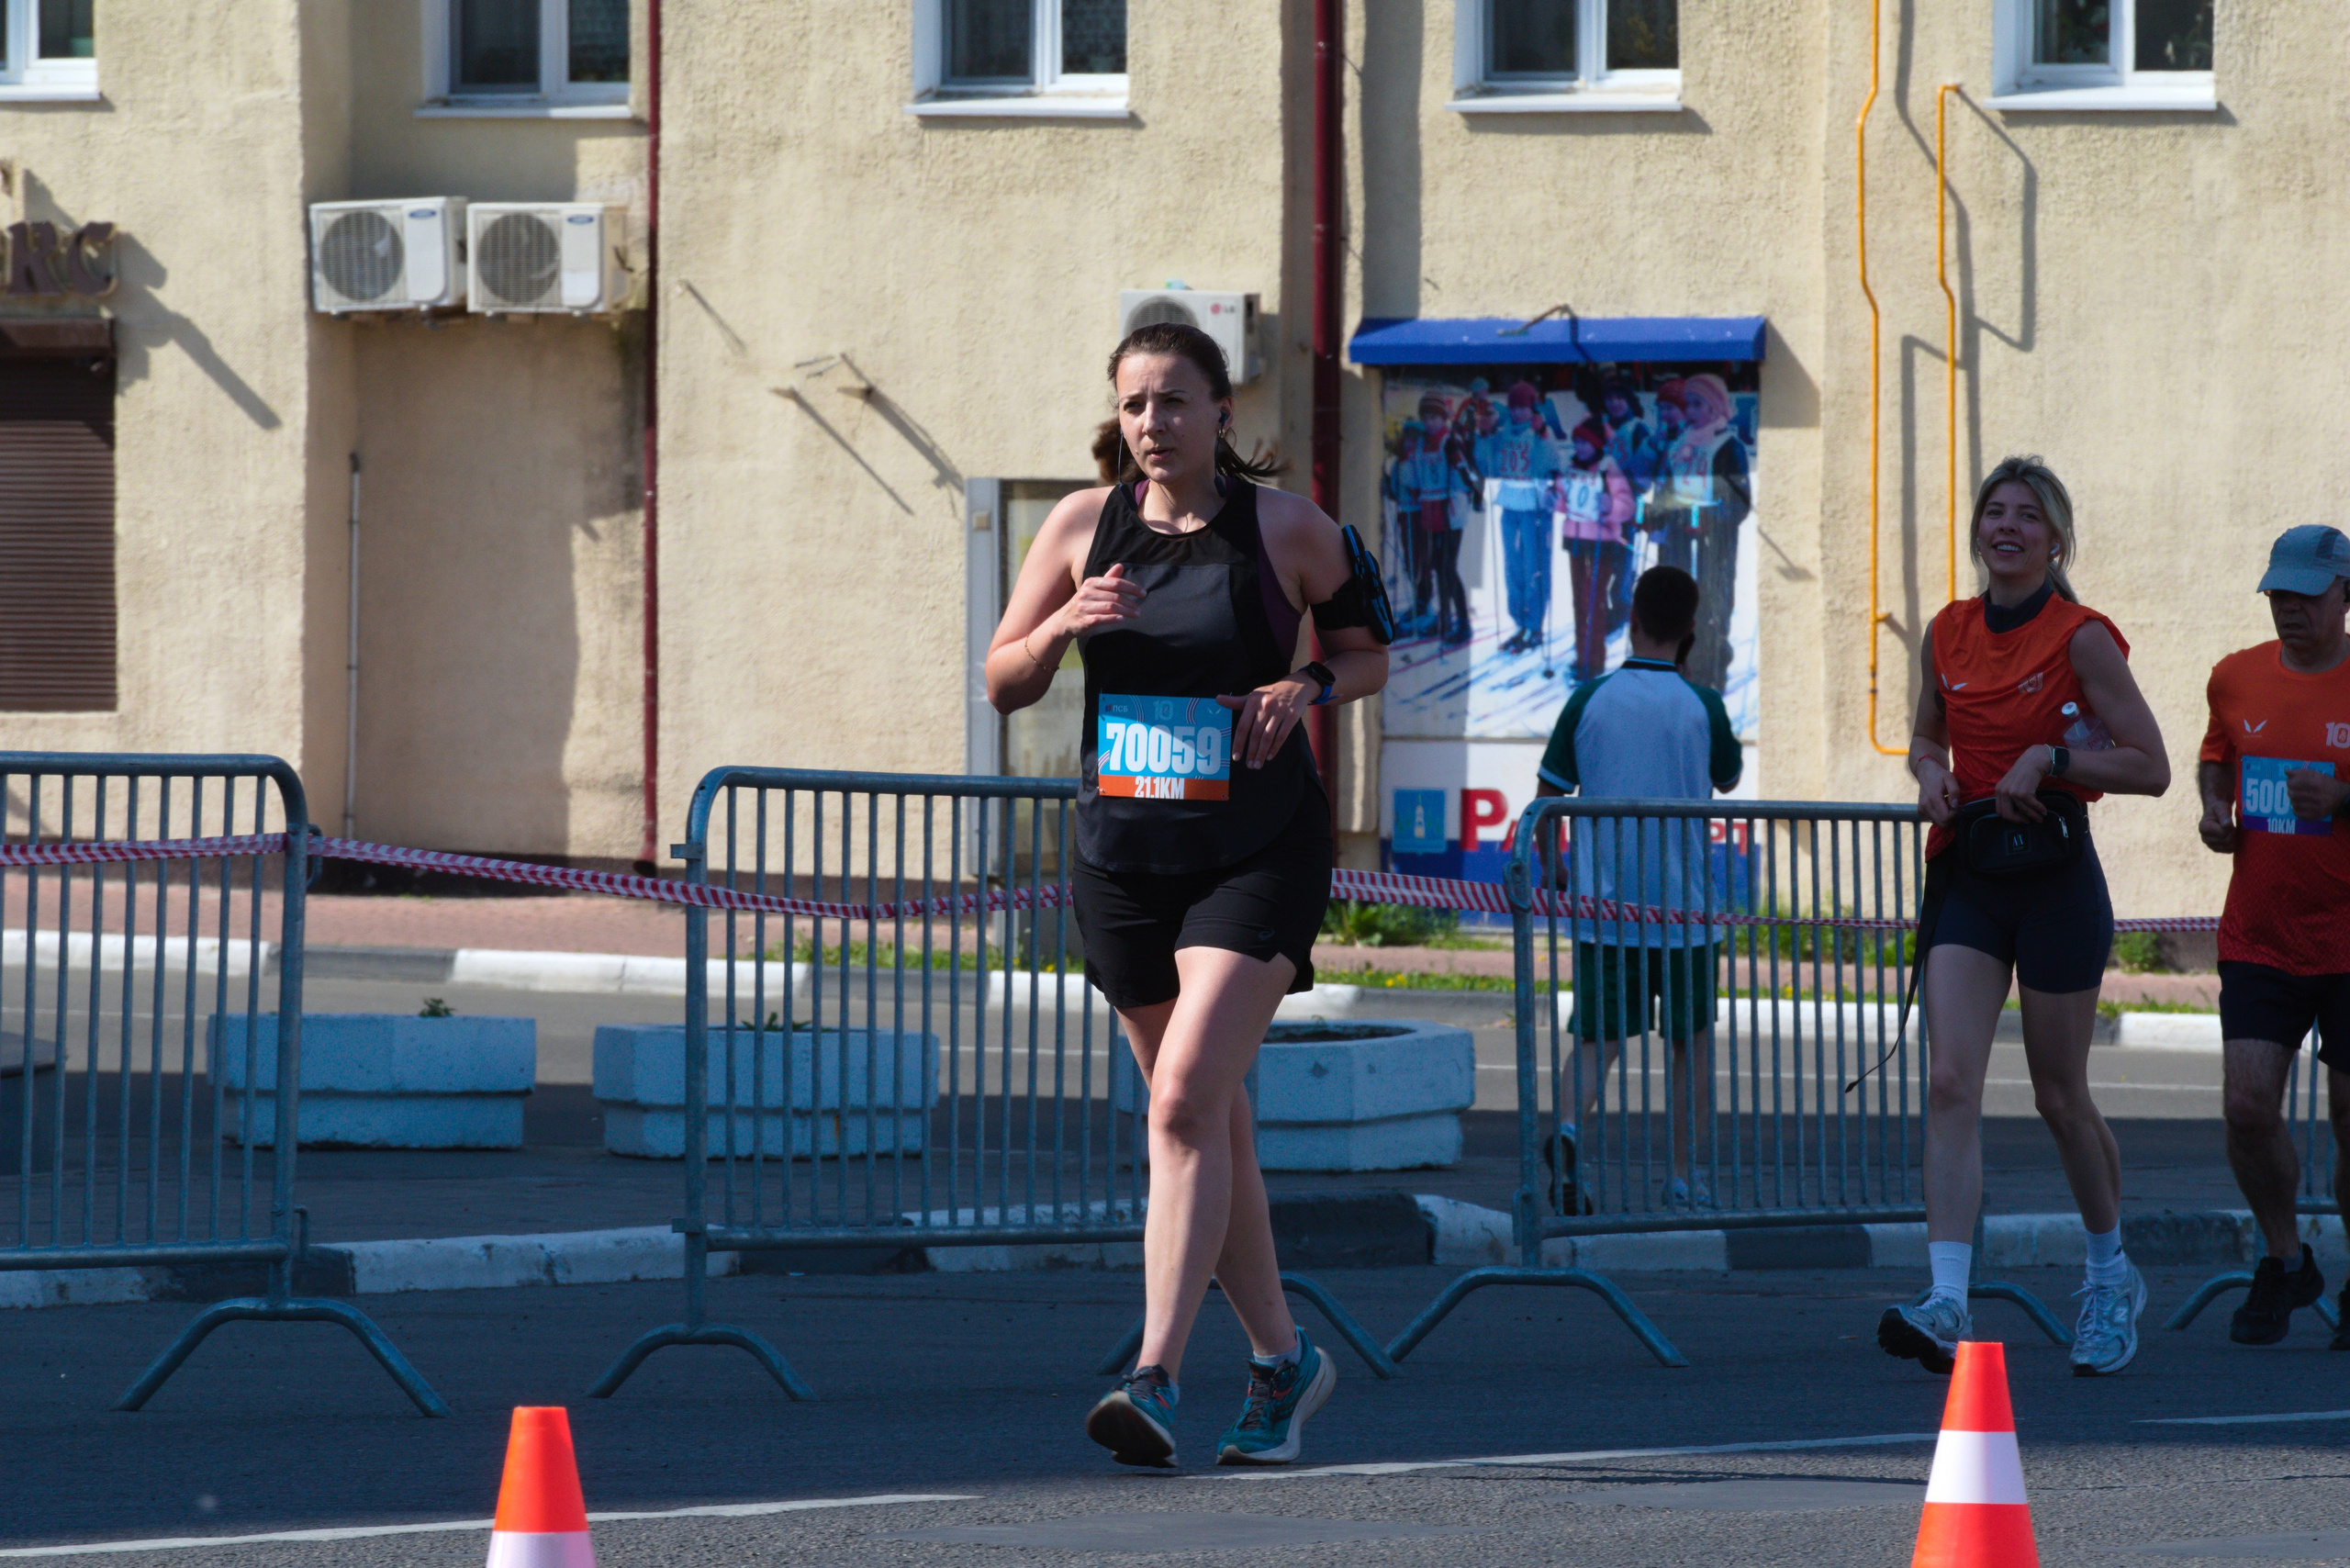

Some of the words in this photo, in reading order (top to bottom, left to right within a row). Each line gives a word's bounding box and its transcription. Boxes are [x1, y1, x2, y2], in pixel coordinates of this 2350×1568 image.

[1113, 704, 1128, 712] ПСБ
[1106, 722, 1222, 775] 70059
[1135, 776, 1185, 801] 21.1KM
[2246, 778, 2291, 815] 500
[2266, 817, 2296, 834] 10KM
